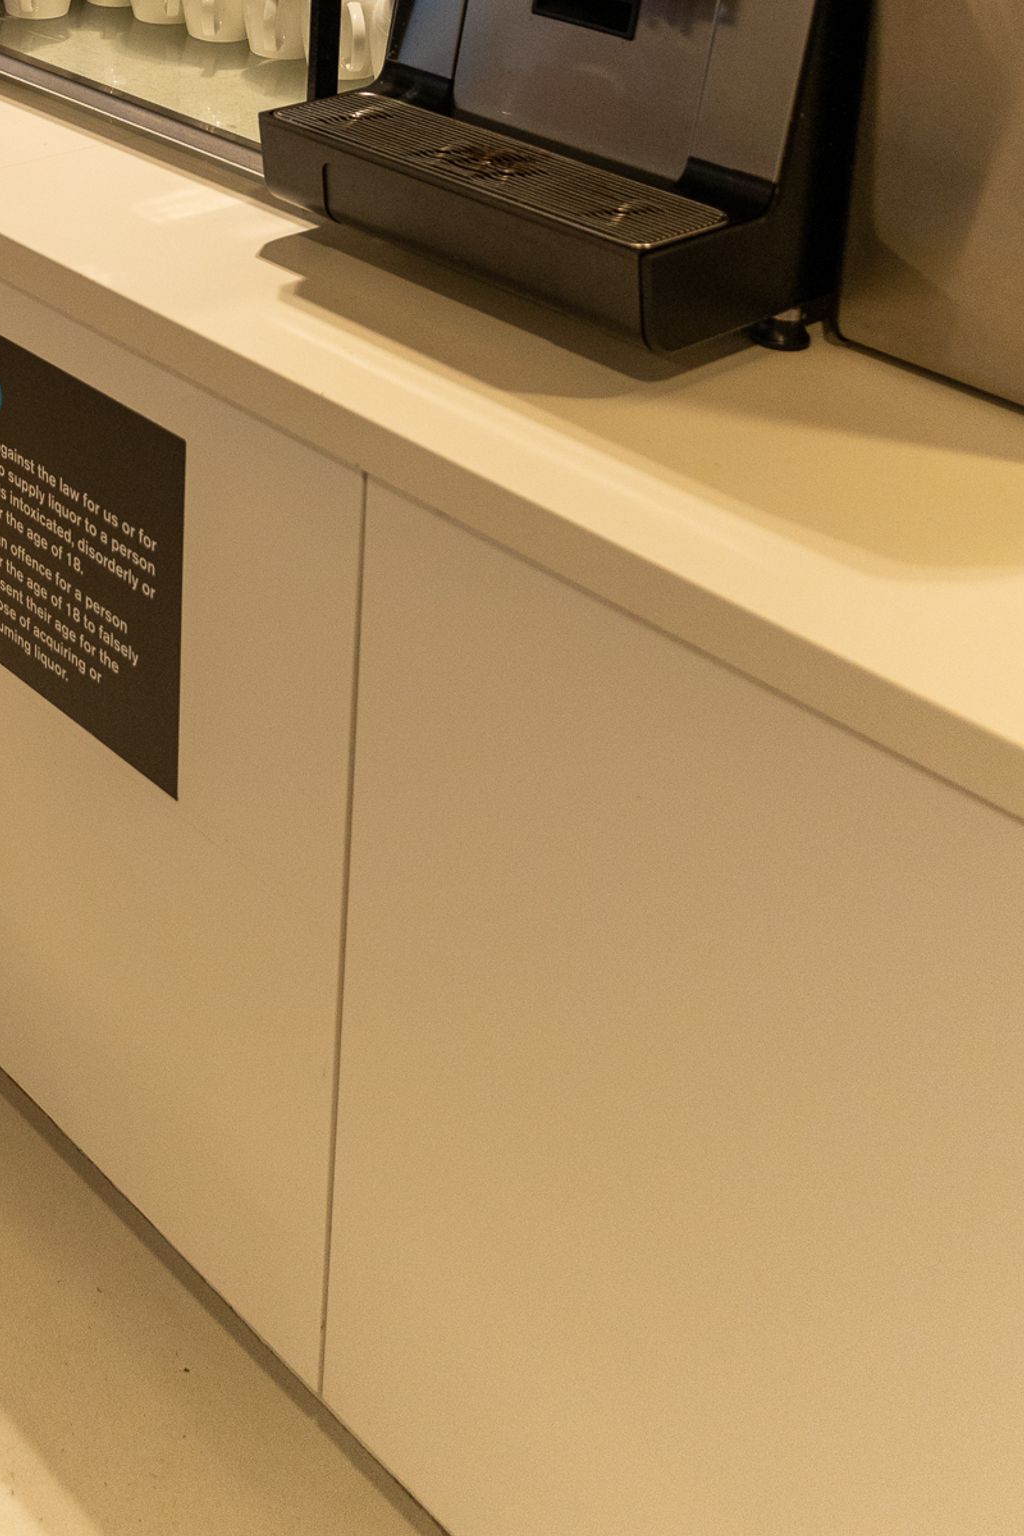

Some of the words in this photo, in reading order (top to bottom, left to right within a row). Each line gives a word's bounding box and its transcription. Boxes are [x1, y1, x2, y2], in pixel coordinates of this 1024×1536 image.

[6, 510, 24, 533] the
[27, 526, 48, 550] age
[51, 543, 64, 560] of
[67, 552, 84, 575] 18.
[8, 470, 45, 505] supply
[48, 493, 82, 527] liquor
[85, 518, 97, 536] to
[100, 530, 108, 545] a
[112, 539, 156, 576] person
[10, 489, 75, 548] intoxicated,
[78, 538, 139, 590] disorderly
[142, 584, 156, 600] or
[37, 466, 56, 488] the
[59, 477, 80, 502] law
[83, 492, 100, 515] for
[104, 509, 119, 527] us
[122, 521, 135, 538] or
[139, 528, 157, 551] for
[6, 559, 24, 582] the
[27, 574, 48, 599] age
[51, 594, 63, 610] of
[66, 603, 81, 623] 18
[83, 614, 96, 633] to
[98, 625, 139, 667] falsely
[10, 542, 52, 580] offence
[55, 571, 72, 593] for
[75, 588, 82, 602] a
[85, 595, 128, 634] person
[19, 615, 32, 631] of
[33, 624, 86, 674] acquiring
[89, 667, 103, 684] or
[26, 594, 53, 625] their
[54, 619, 77, 643] age
[79, 634, 97, 656] for
[99, 649, 119, 674] the
[34, 646, 69, 682] liquor.
